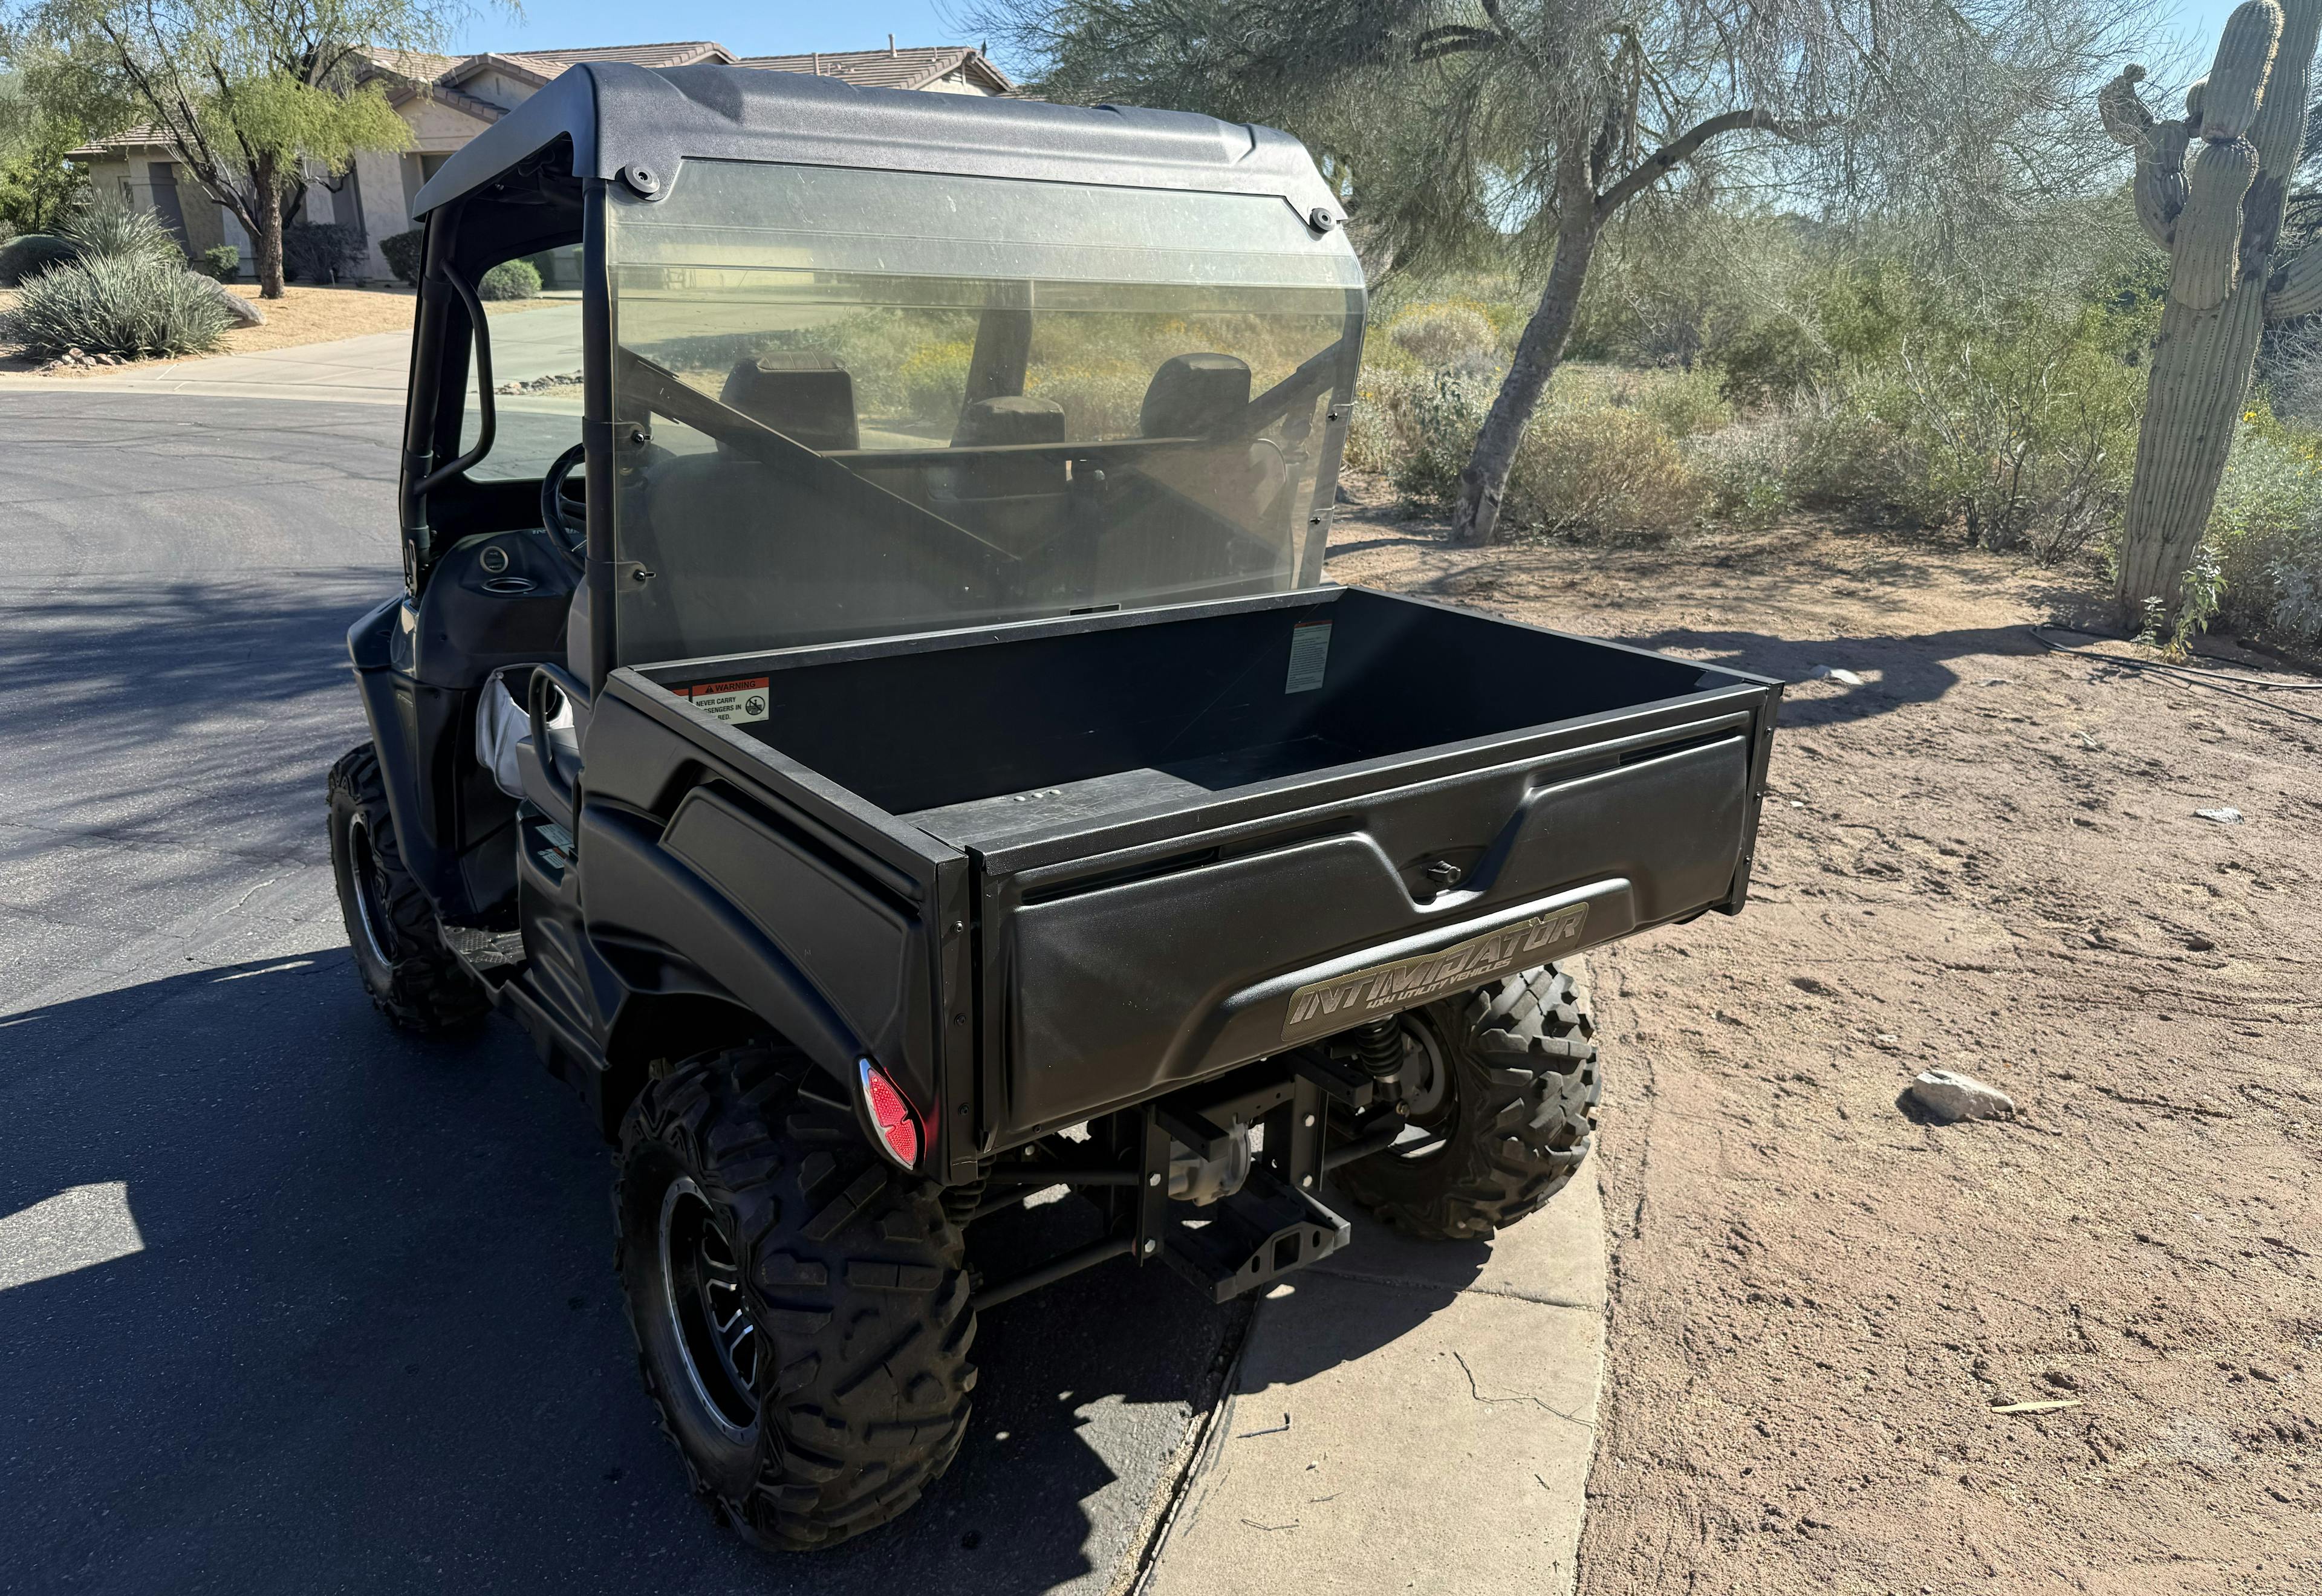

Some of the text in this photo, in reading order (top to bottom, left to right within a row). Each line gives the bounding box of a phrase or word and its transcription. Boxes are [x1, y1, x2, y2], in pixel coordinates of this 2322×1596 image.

[715, 681, 756, 692] WARNING
[704, 705, 734, 713] SENGERS
[1290, 909, 1584, 1025] INTIMIDATOR
[1397, 980, 1449, 1001] UTILITY
[1450, 958, 1513, 984] VEHICLES
